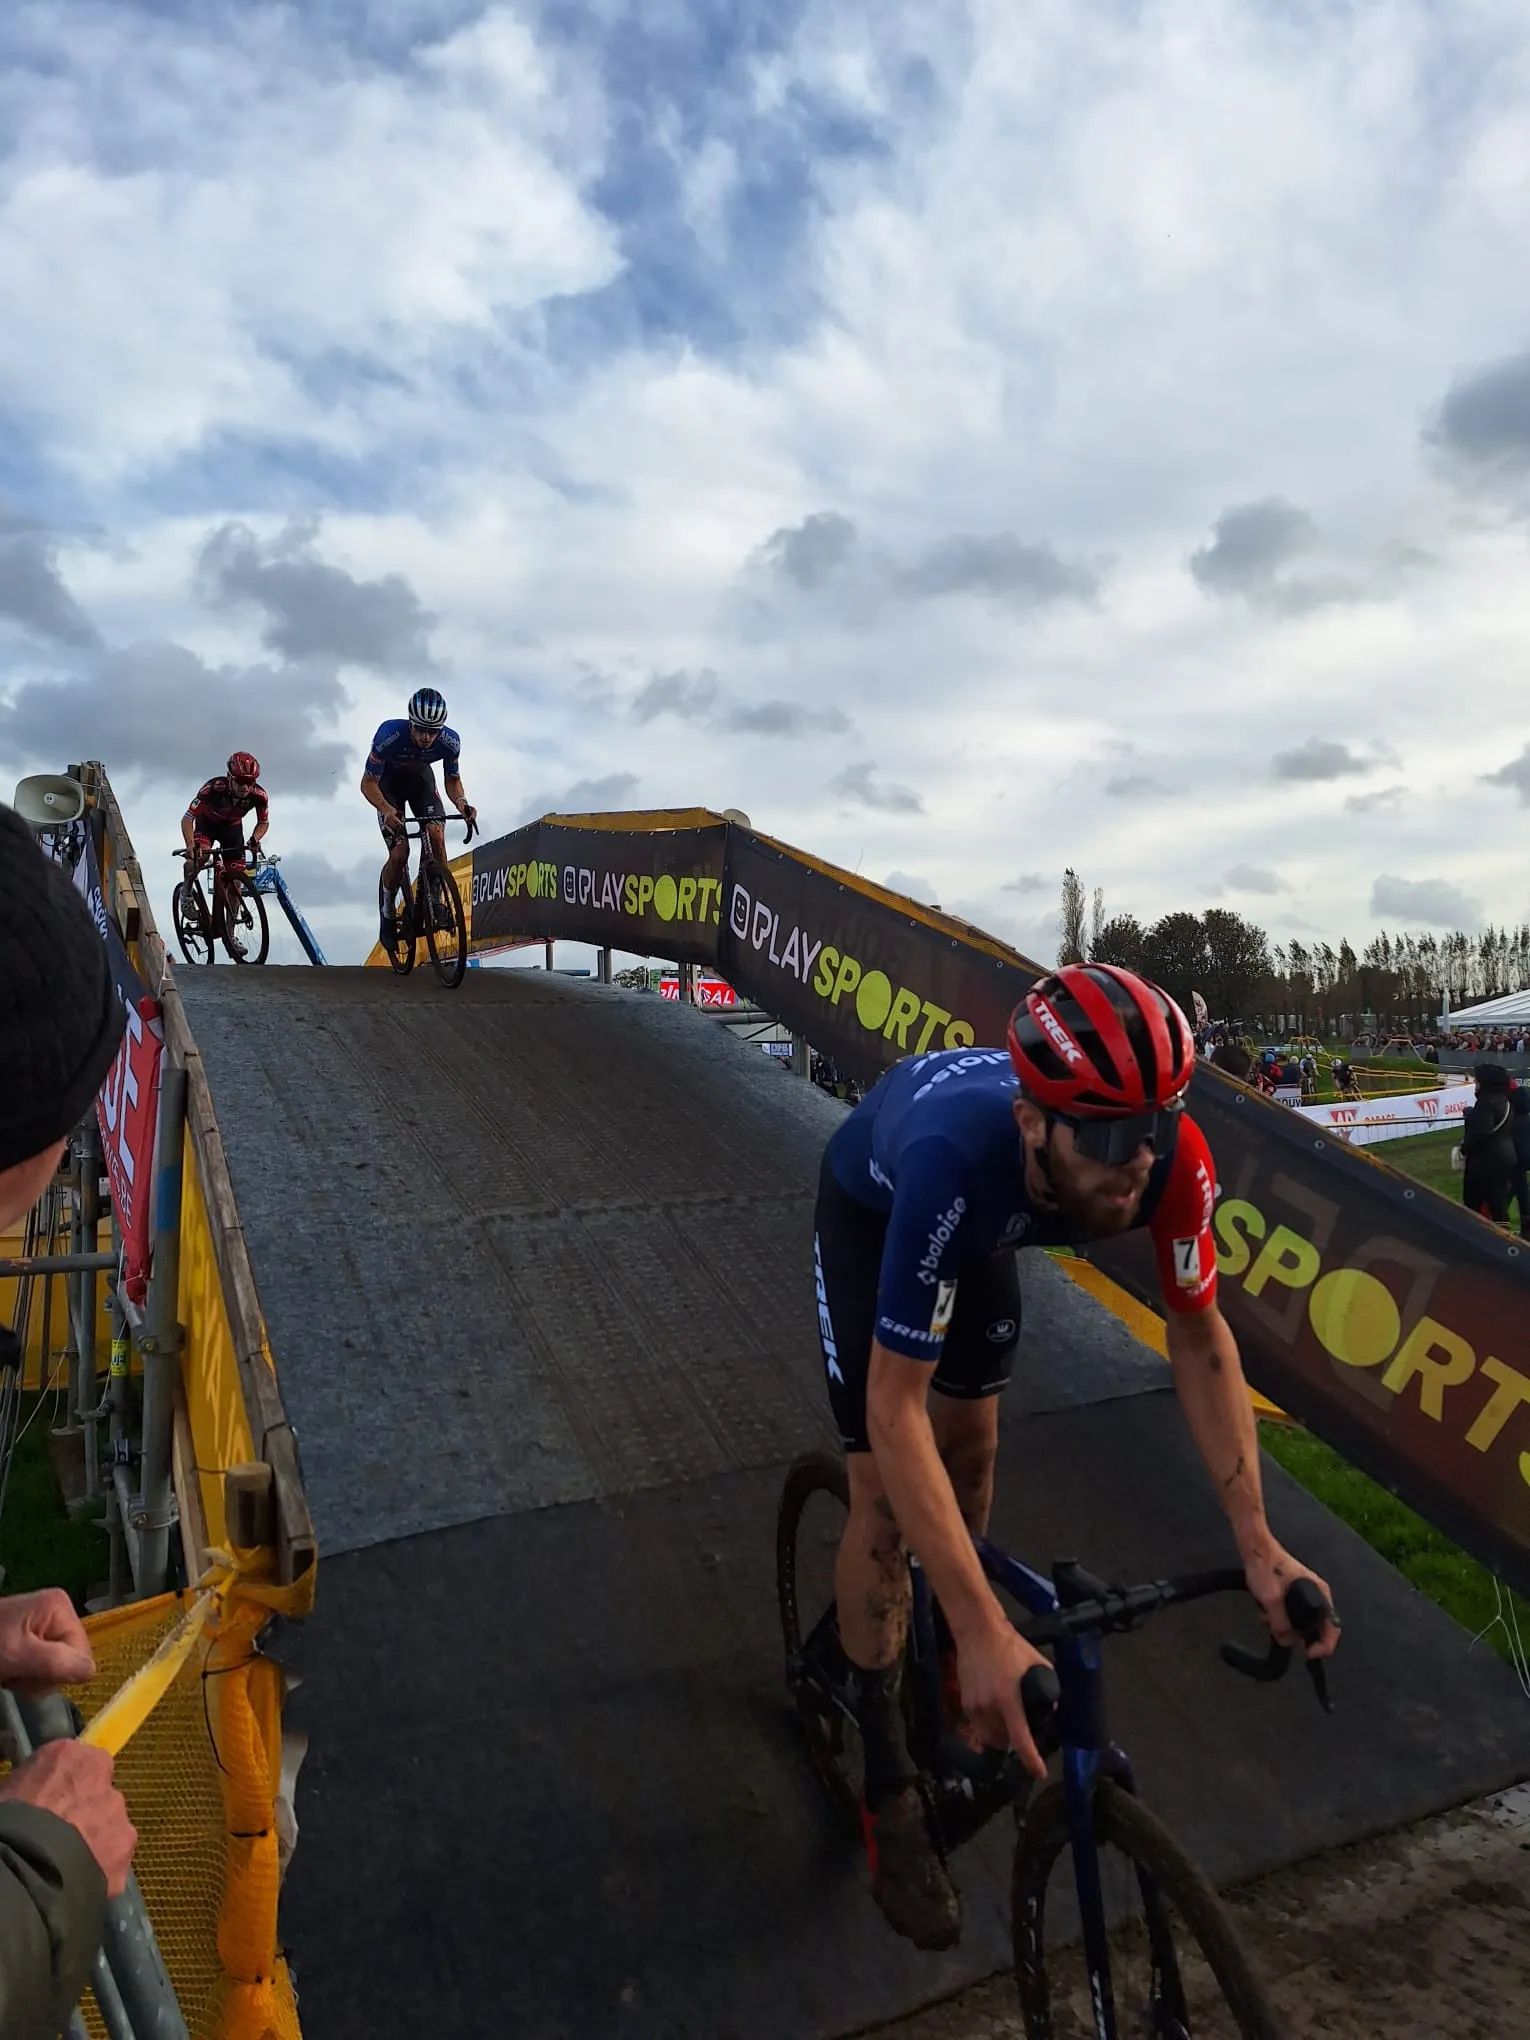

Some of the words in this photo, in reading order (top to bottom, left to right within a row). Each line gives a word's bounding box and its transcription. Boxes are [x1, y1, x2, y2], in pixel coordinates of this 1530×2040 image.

[1035, 1000, 1083, 1063] TREK
[920, 1196, 967, 1270] baloise
[1177, 1239, 1196, 1270] 7
[814, 1231, 845, 1385] TREK
[937, 1279, 955, 1318] 7
